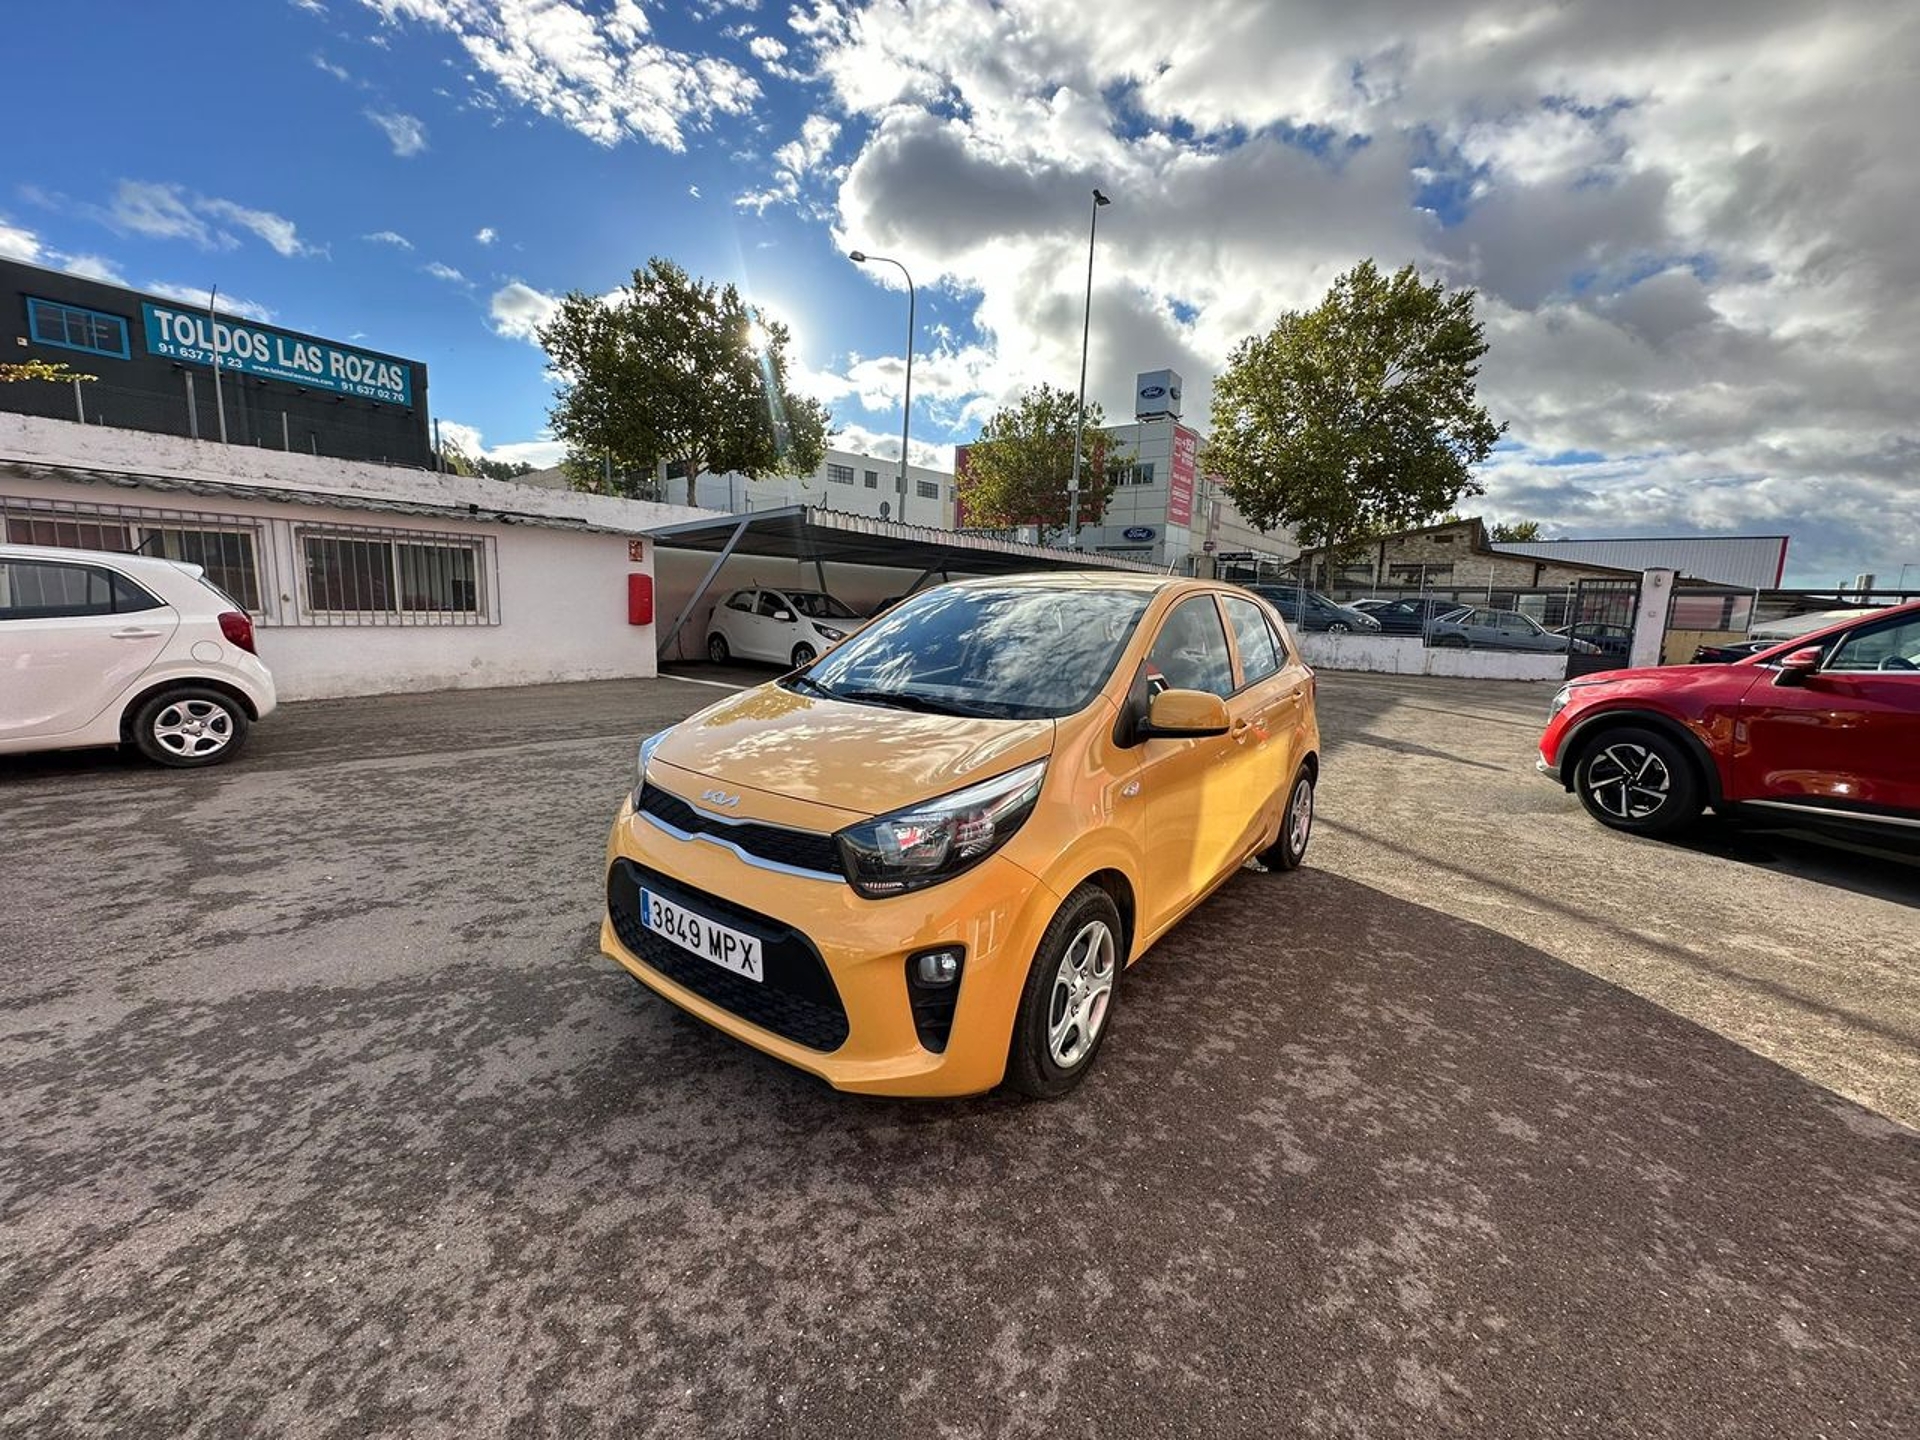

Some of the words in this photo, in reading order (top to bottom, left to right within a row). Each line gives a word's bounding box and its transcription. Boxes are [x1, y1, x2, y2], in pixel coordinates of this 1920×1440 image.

[154, 309, 271, 362] TOLDOS
[276, 338, 324, 375] LAS
[329, 351, 404, 392] ROZAS
[158, 343, 175, 354] 91
[180, 347, 204, 360] 637
[227, 357, 243, 368] 23
[341, 382, 354, 392] 91
[357, 386, 376, 396] 637
[377, 389, 390, 400] 02
[393, 393, 405, 402] 70
[653, 901, 701, 949] 3849
[708, 926, 755, 974] MPX
